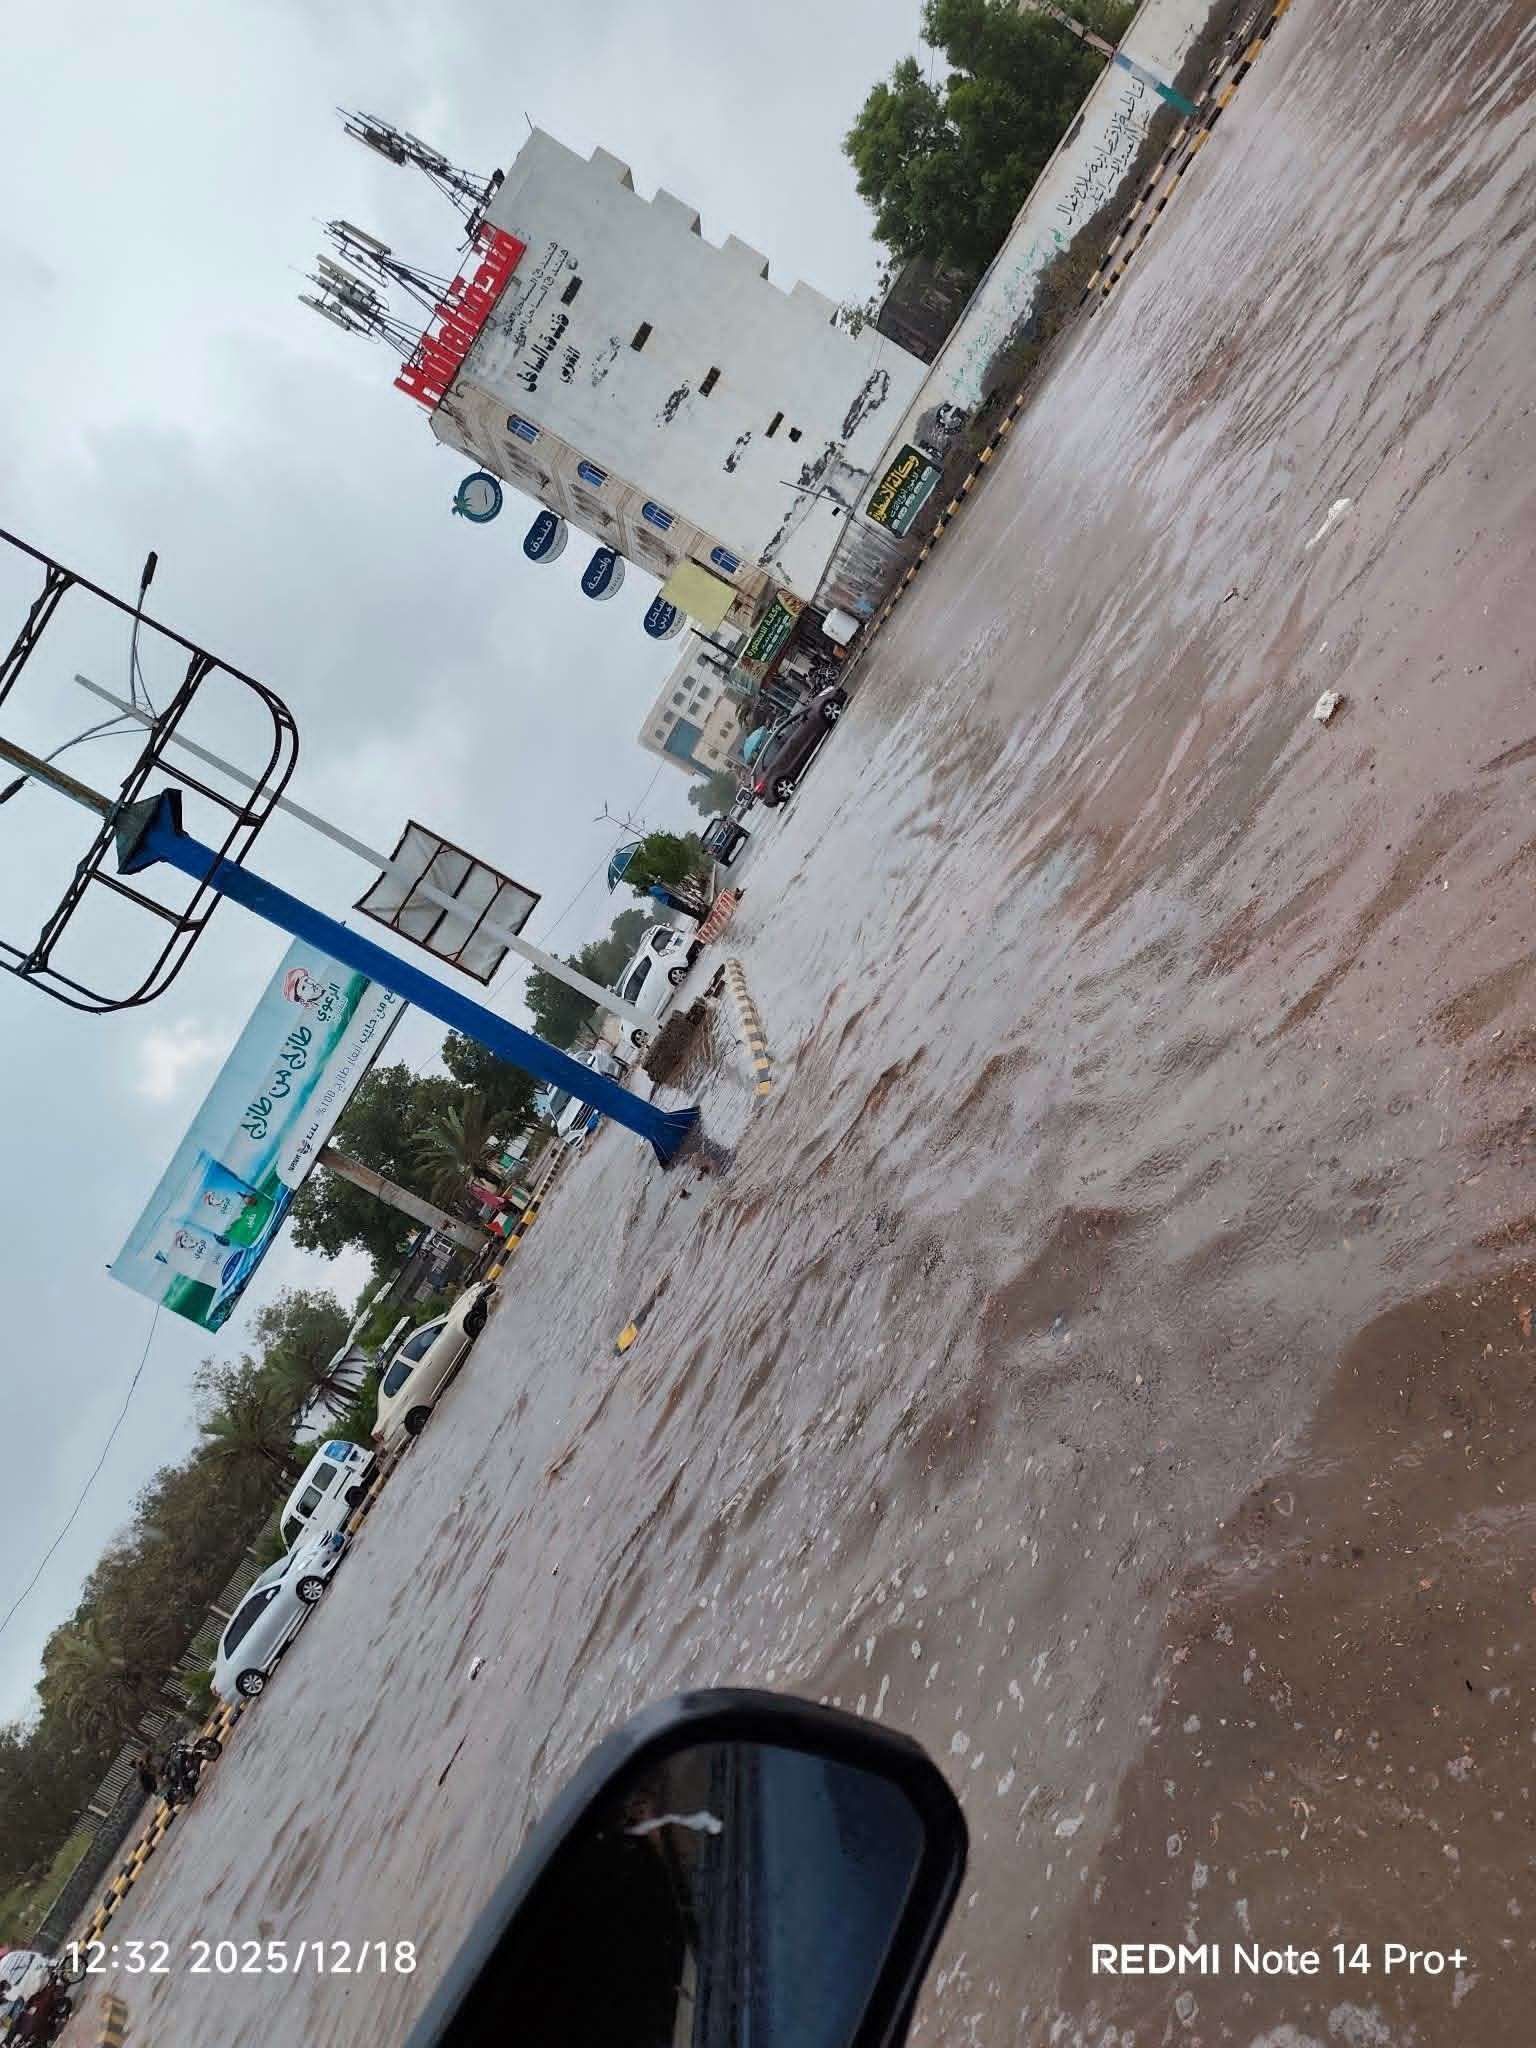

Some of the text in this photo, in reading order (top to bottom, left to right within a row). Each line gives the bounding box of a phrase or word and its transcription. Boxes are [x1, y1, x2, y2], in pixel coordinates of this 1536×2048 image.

[539, 312, 569, 351] فندق
[393, 301, 480, 412] Hotel
[887, 454, 919, 488] وكالة
[529, 519, 552, 552] فندق
[318, 982, 339, 1021] الرعوي
[241, 1024, 311, 1139] طازج من طازج
